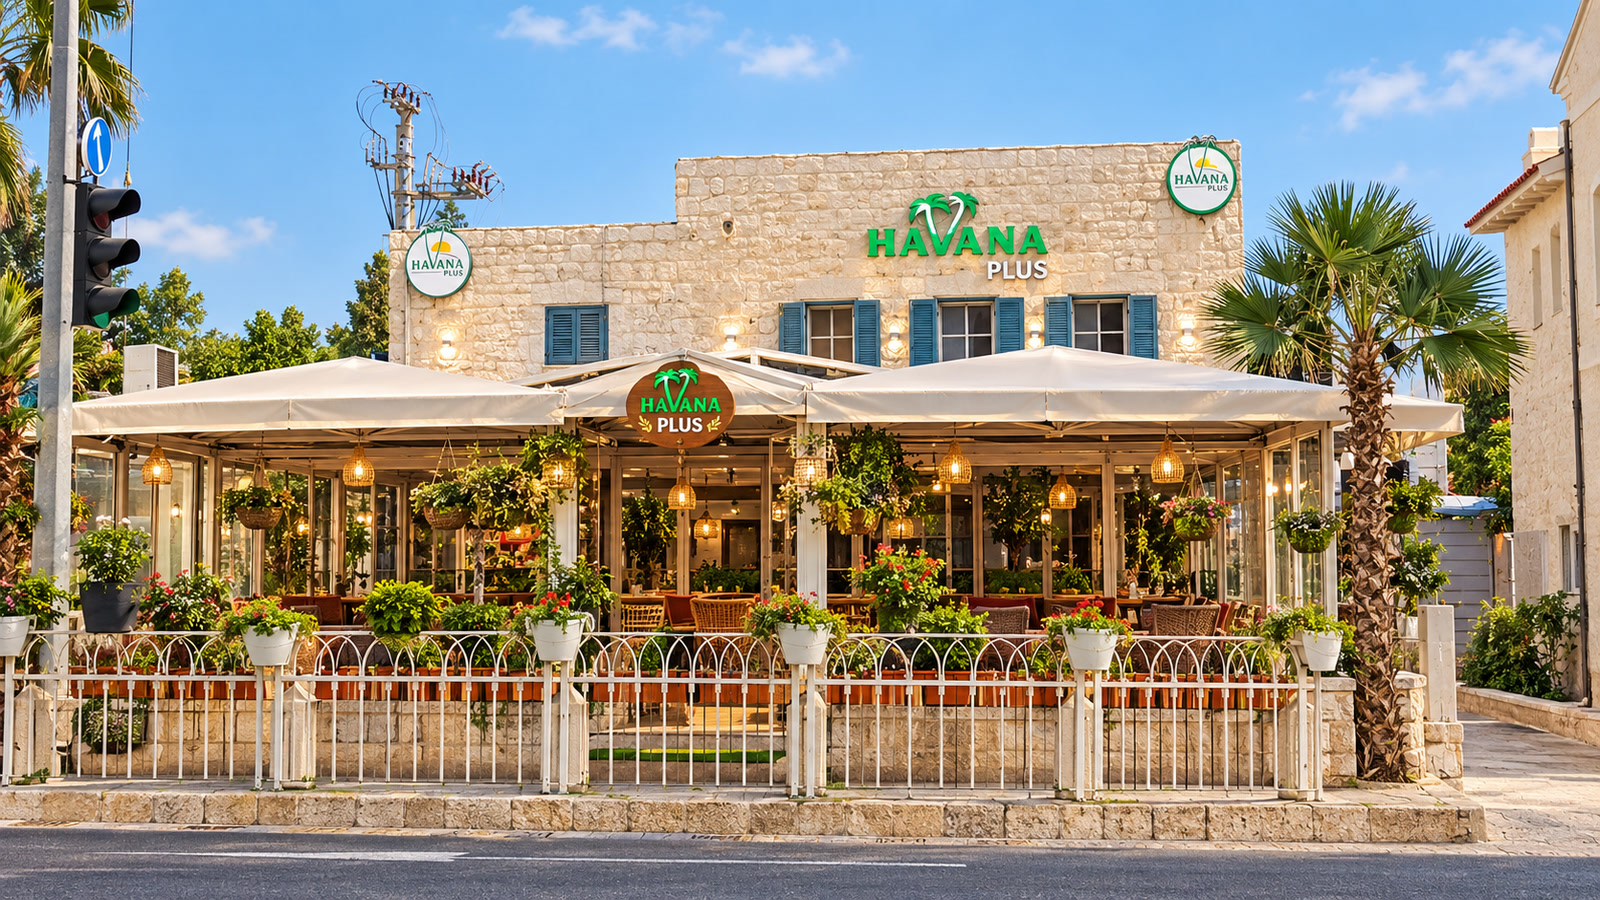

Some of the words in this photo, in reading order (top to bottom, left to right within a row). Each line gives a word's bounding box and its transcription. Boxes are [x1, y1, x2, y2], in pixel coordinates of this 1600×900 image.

[1174, 173, 1229, 185] HAVANA
[1207, 184, 1229, 192] PLUS
[867, 225, 1048, 257] HAVANA
[411, 258, 464, 270] HAVANA
[987, 260, 1048, 280] PLUS
[443, 269, 464, 277] PLUS
[640, 397, 722, 413] HAVANA
[657, 417, 703, 433] PLUS
